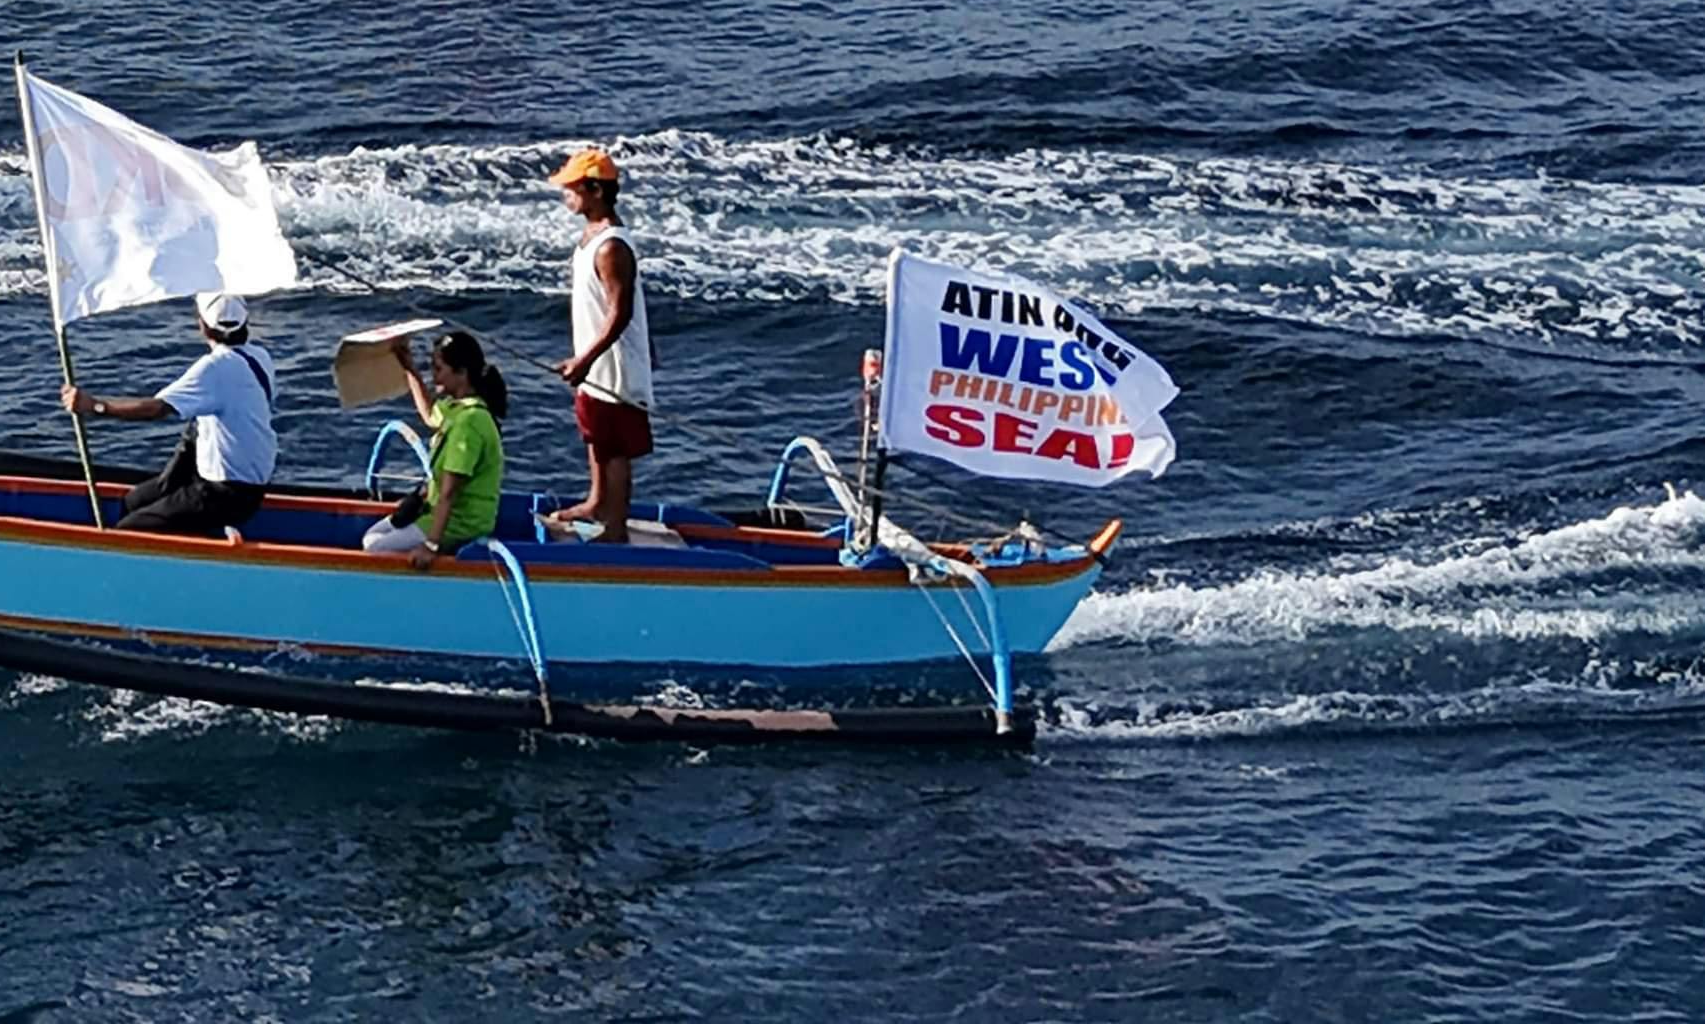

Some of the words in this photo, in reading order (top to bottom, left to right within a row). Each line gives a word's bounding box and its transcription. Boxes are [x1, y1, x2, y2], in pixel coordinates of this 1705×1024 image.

[941, 280, 1044, 327] ATIN
[939, 322, 1118, 390] WES
[929, 368, 1128, 427] PHILIPPIN
[925, 404, 1135, 469] SEA!
